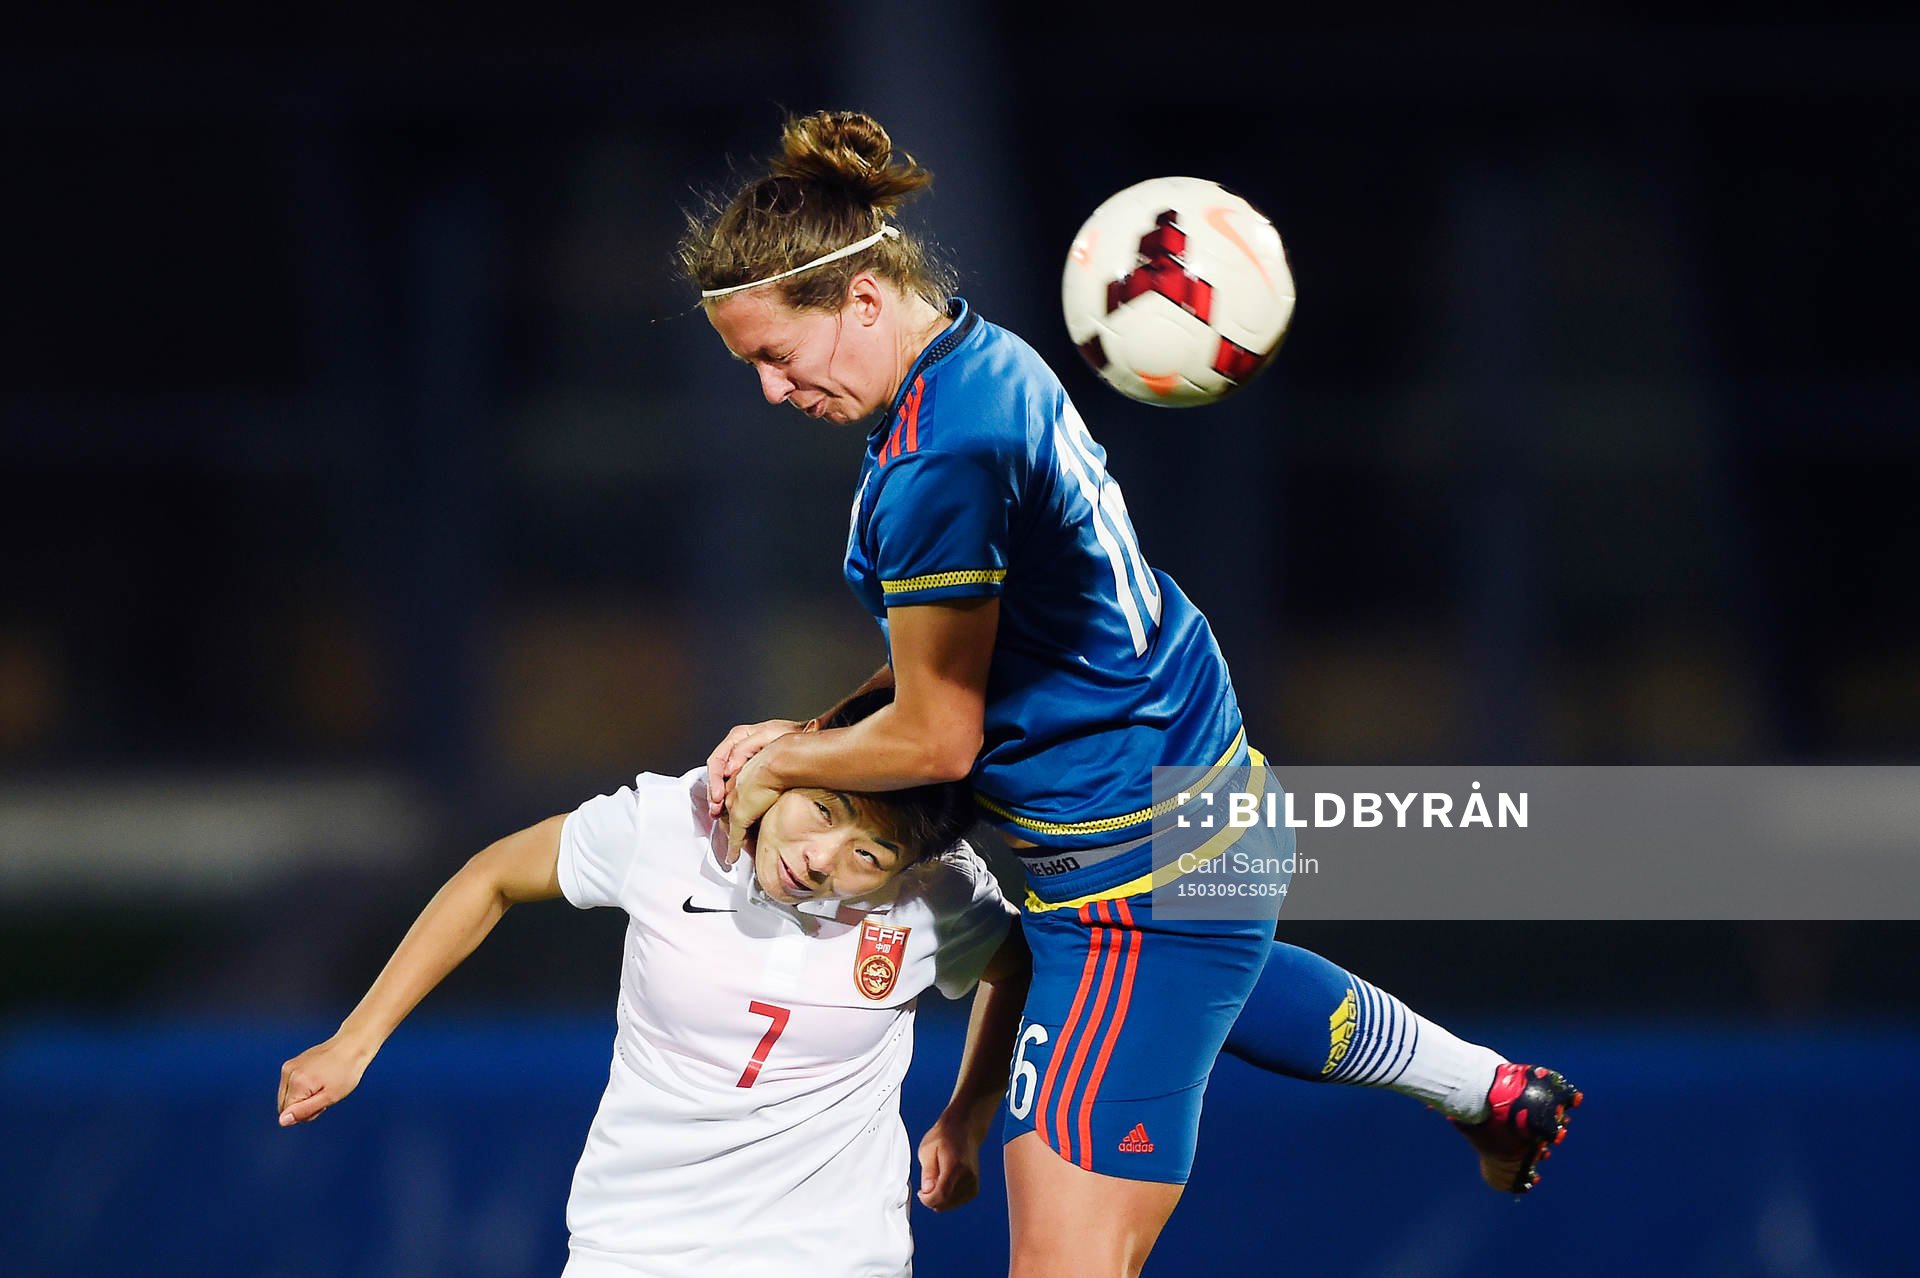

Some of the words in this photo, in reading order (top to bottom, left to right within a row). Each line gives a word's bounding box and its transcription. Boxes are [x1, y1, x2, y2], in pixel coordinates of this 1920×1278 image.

[864, 925, 906, 945] CFA
[736, 1000, 790, 1088] 7
[1118, 1142, 1155, 1153] adidas
